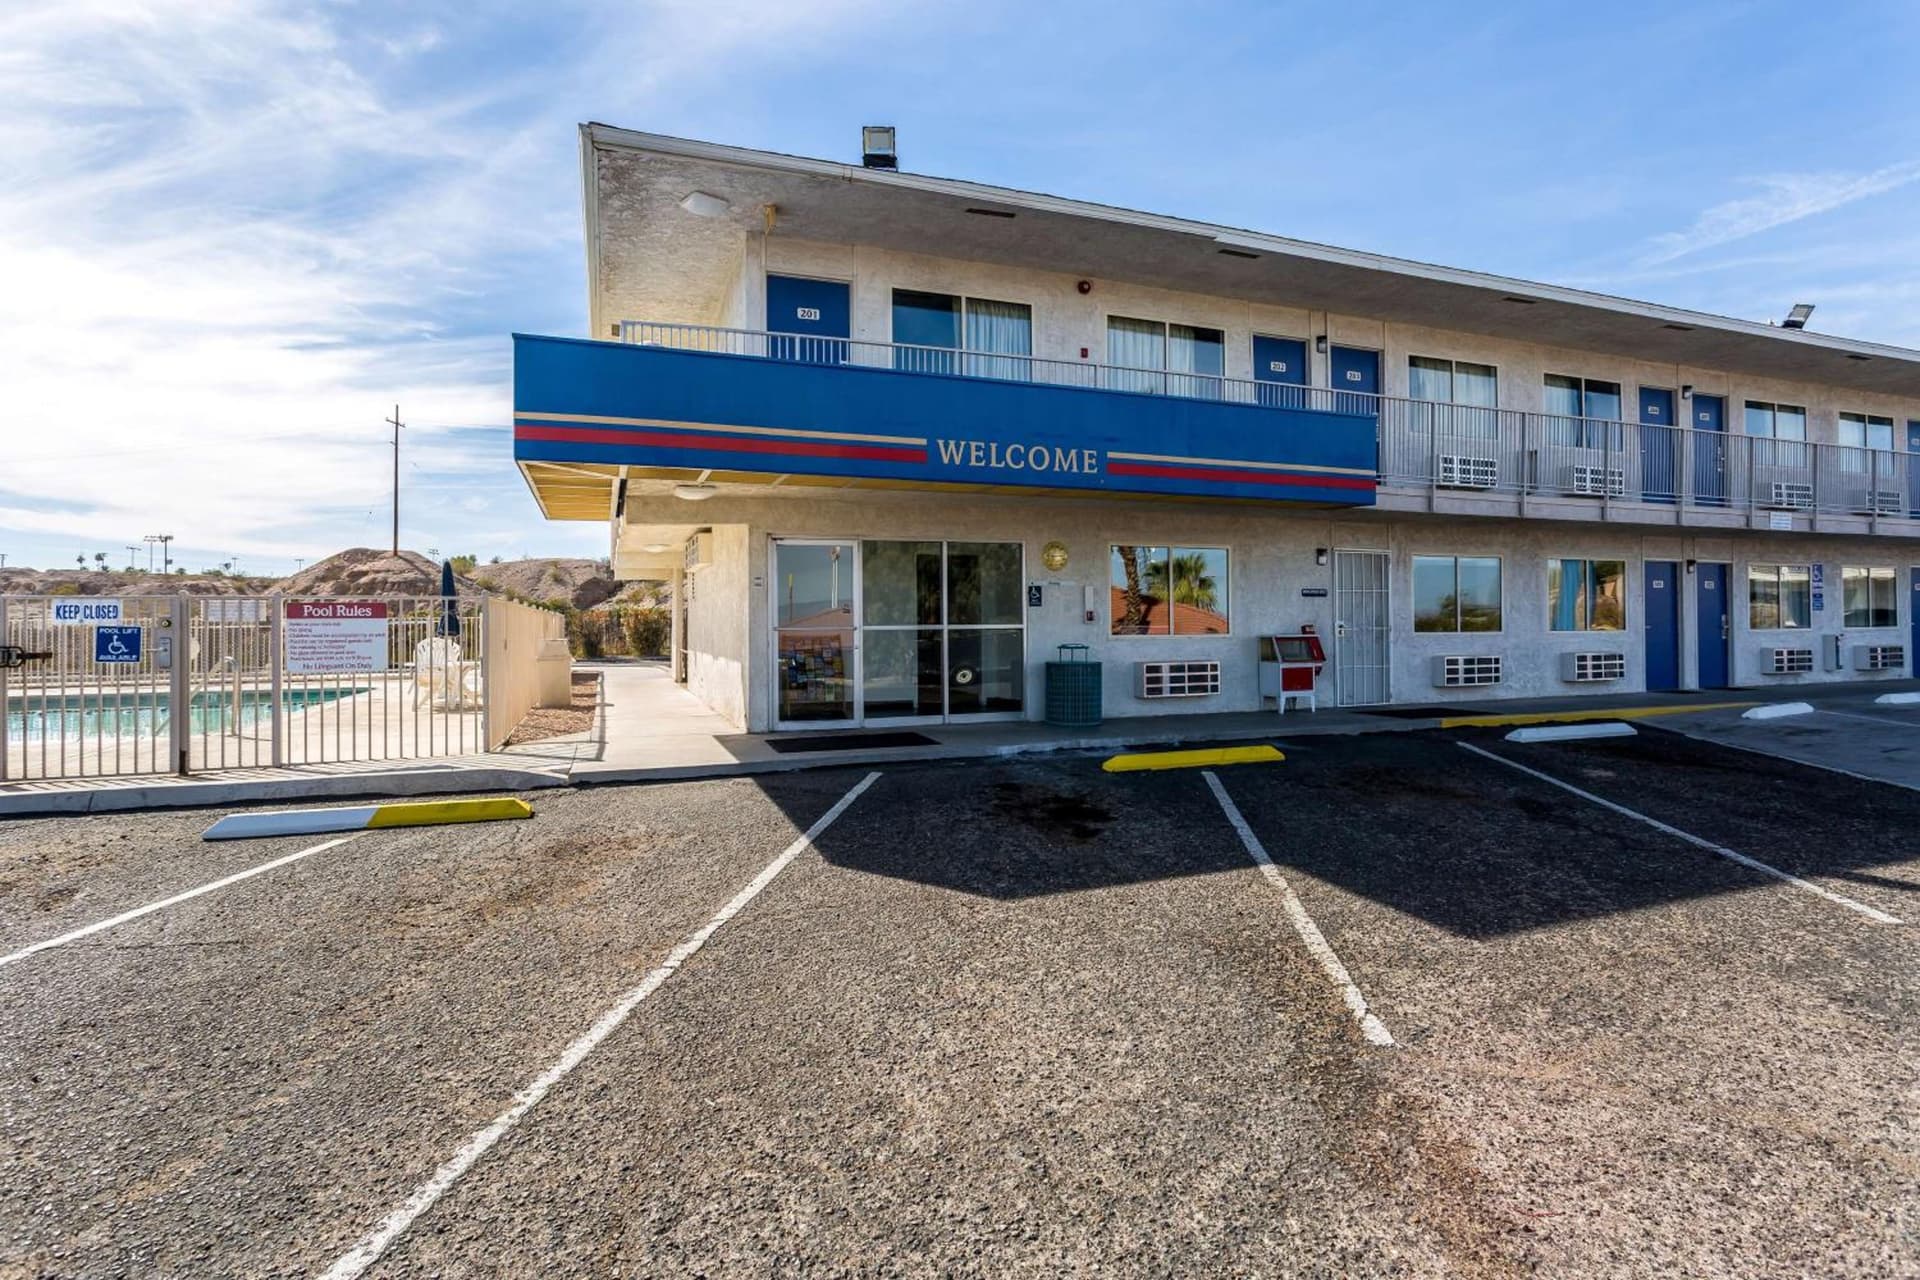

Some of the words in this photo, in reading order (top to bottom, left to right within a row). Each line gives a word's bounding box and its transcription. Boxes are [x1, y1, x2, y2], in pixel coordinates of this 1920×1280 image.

[799, 309, 818, 319] 201
[936, 439, 1099, 474] WELCOME
[56, 604, 80, 619] KEEP
[83, 604, 119, 619] CLOSED
[303, 605, 333, 617] Pool
[336, 605, 373, 617] Rules
